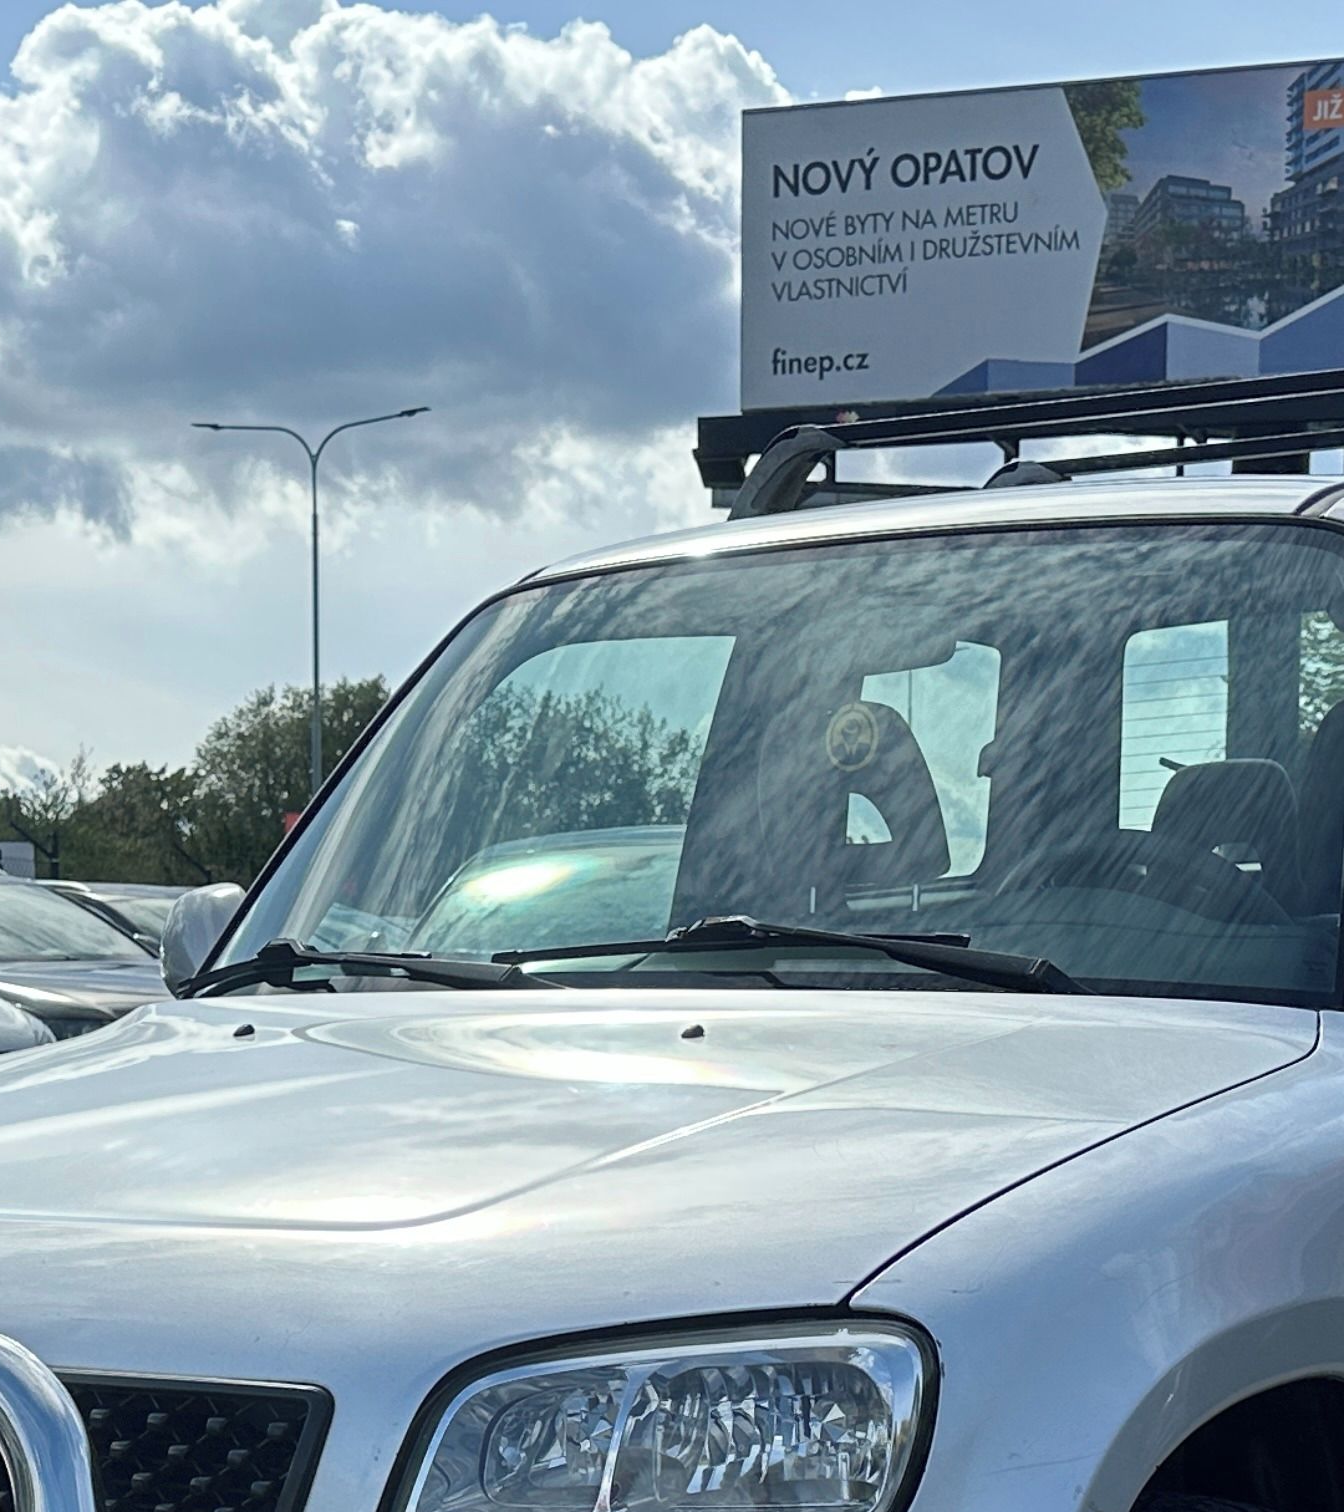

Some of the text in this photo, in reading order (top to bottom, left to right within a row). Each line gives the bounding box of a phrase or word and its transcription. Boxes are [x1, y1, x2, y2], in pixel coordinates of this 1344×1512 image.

[1312, 93, 1344, 122] JIŽ
[771, 143, 1040, 199] NOVÝ OPATOV
[771, 201, 1019, 242] NOVÉ BYTY NA METRU
[771, 223, 1080, 272] V OSOBNÍM I DRUŽSTEVNÍM
[771, 266, 909, 302] VLASTNICTVÍ
[771, 347, 870, 381] finep.cz
